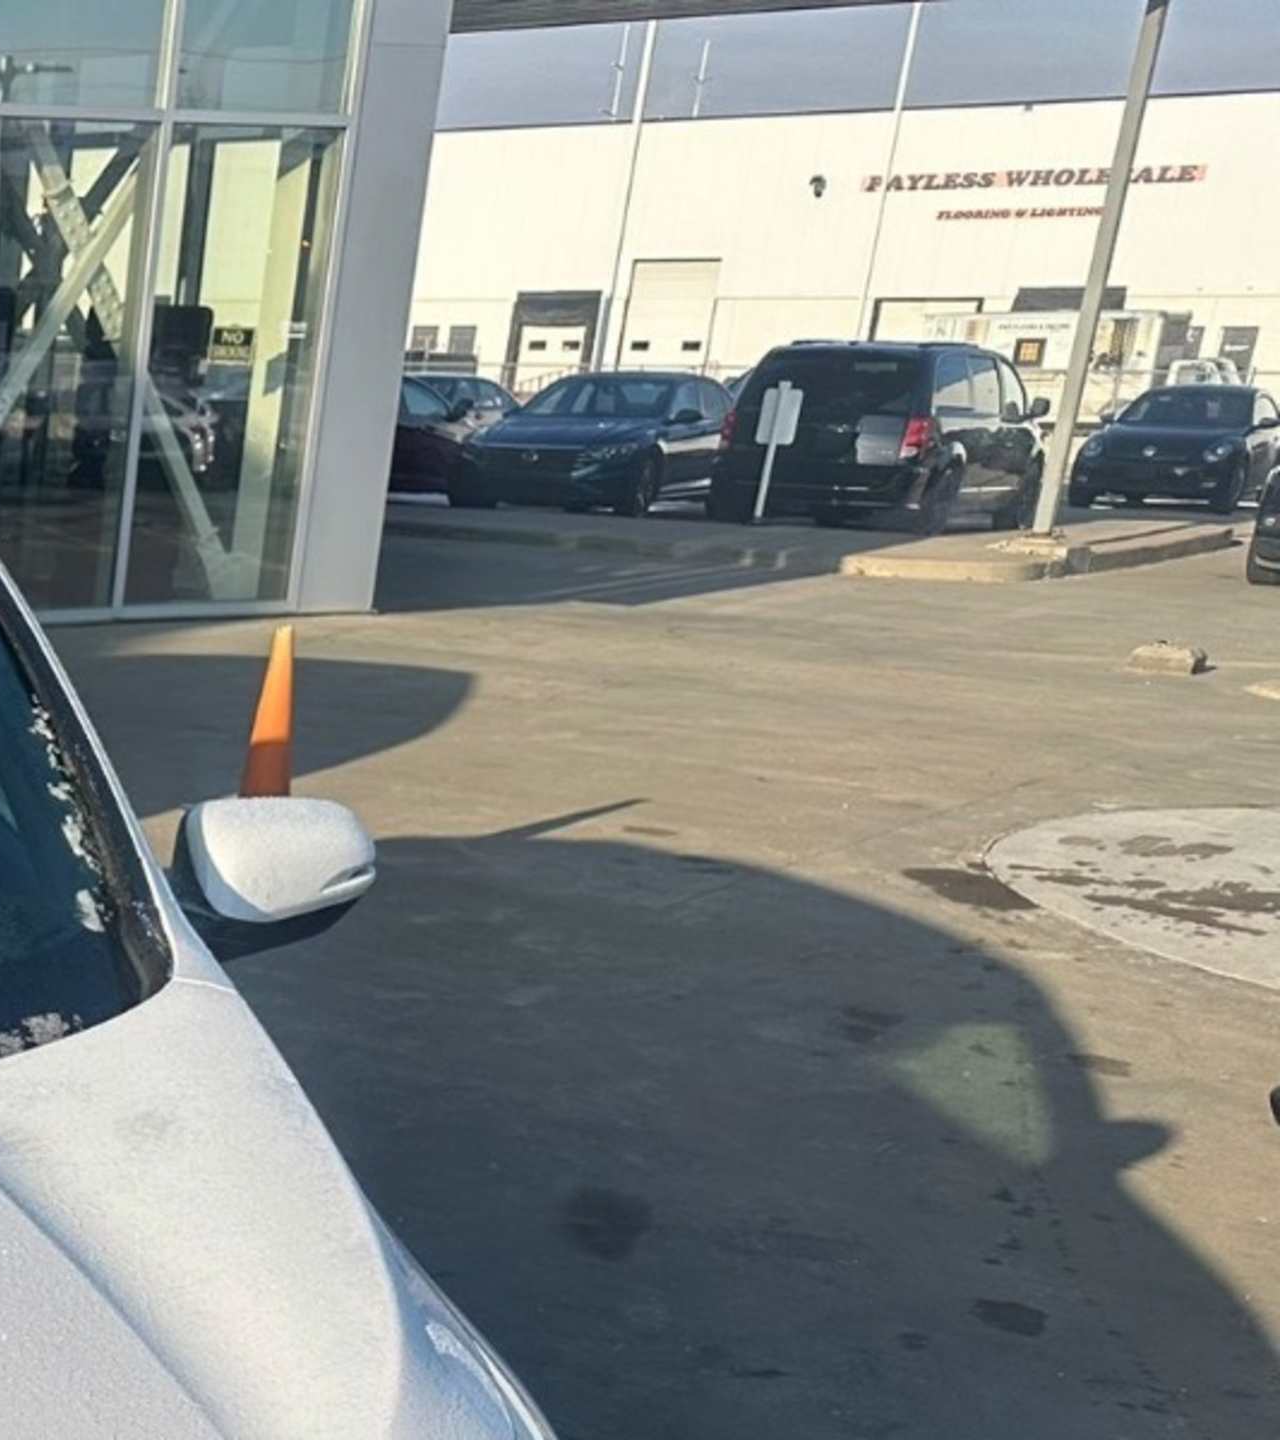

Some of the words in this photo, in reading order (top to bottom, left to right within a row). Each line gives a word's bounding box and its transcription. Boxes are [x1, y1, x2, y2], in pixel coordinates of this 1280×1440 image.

[863, 172, 997, 193] PAYLESS
[1005, 164, 1200, 188] WHOLEALE
[936, 208, 1011, 221] FLOORING
[221, 330, 245, 344] NO
